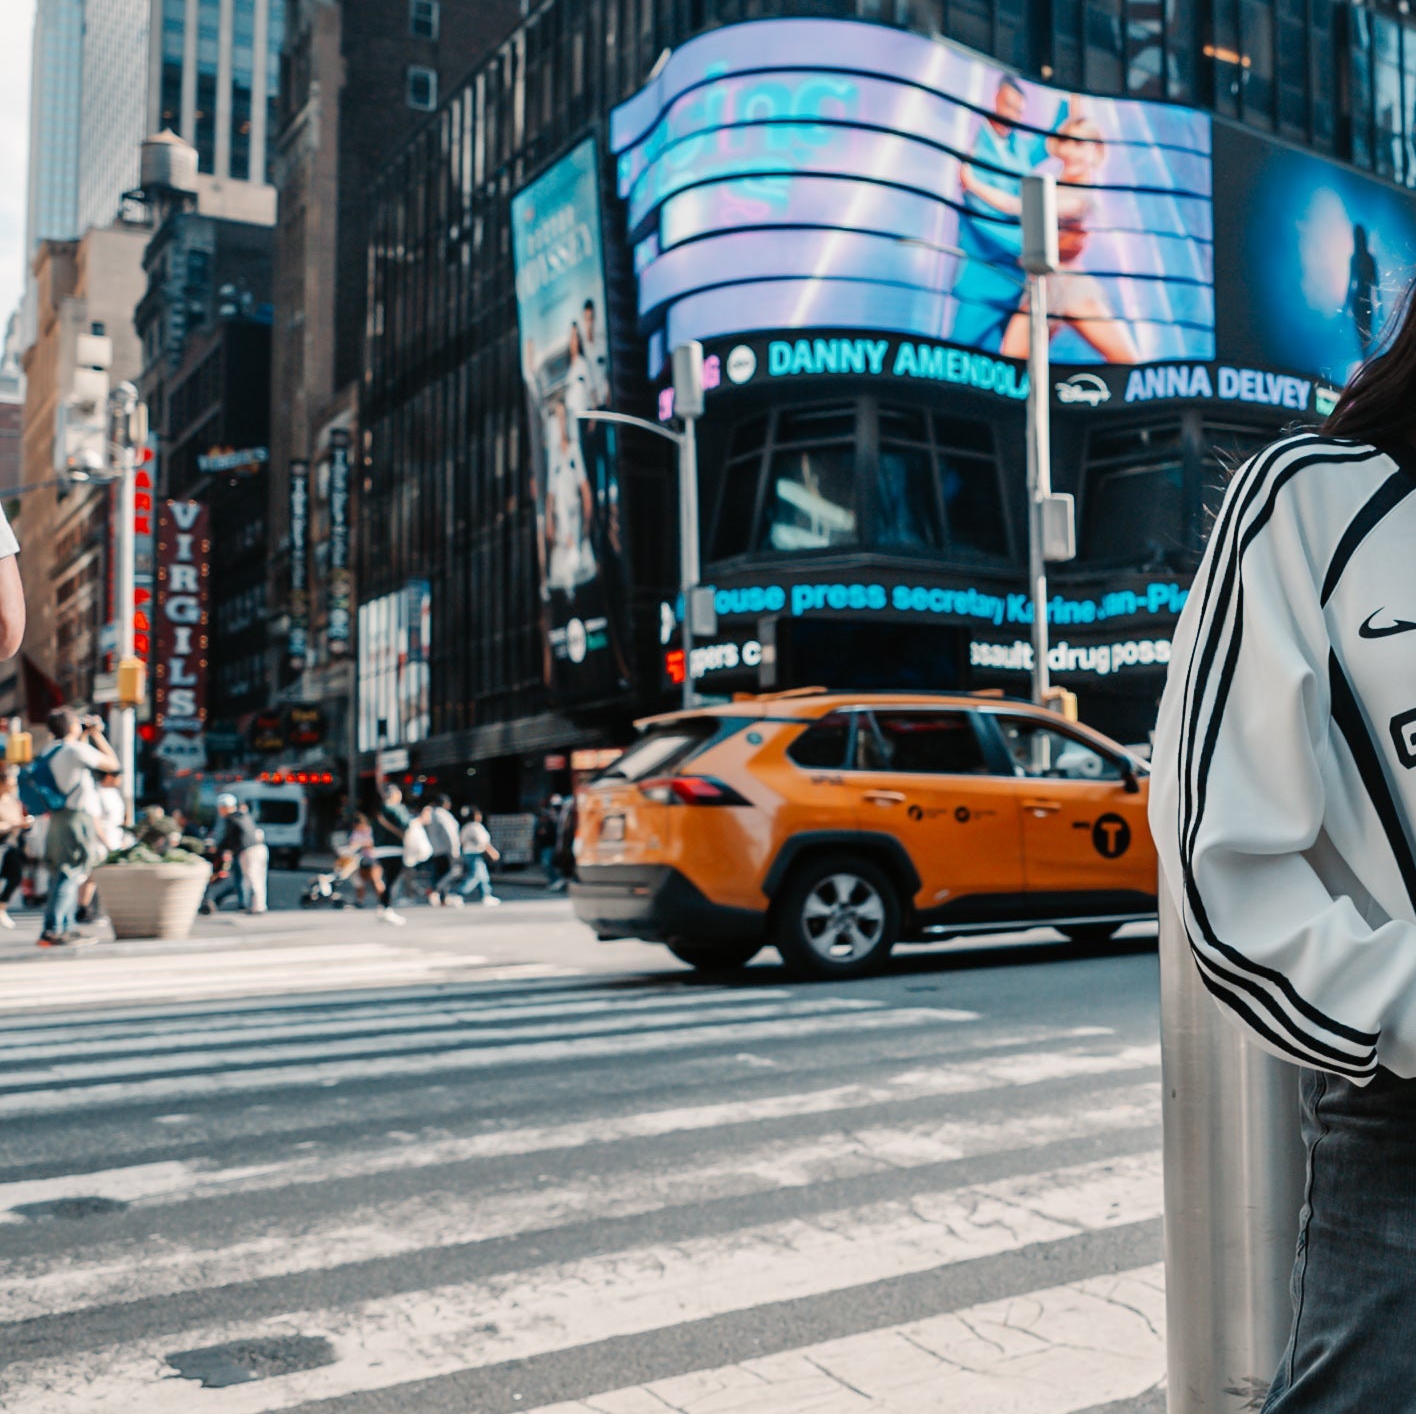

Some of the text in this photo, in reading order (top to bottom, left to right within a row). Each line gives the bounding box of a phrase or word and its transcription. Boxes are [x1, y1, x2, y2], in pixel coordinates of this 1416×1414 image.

[768, 339, 890, 376] DANNY
[1124, 365, 1212, 403] ANNA
[1217, 366, 1311, 411] DELVEY
[791, 584, 886, 617] press
[891, 585, 1004, 625] secretary
[1046, 640, 1111, 675] drug
[1111, 639, 1173, 673] poss
